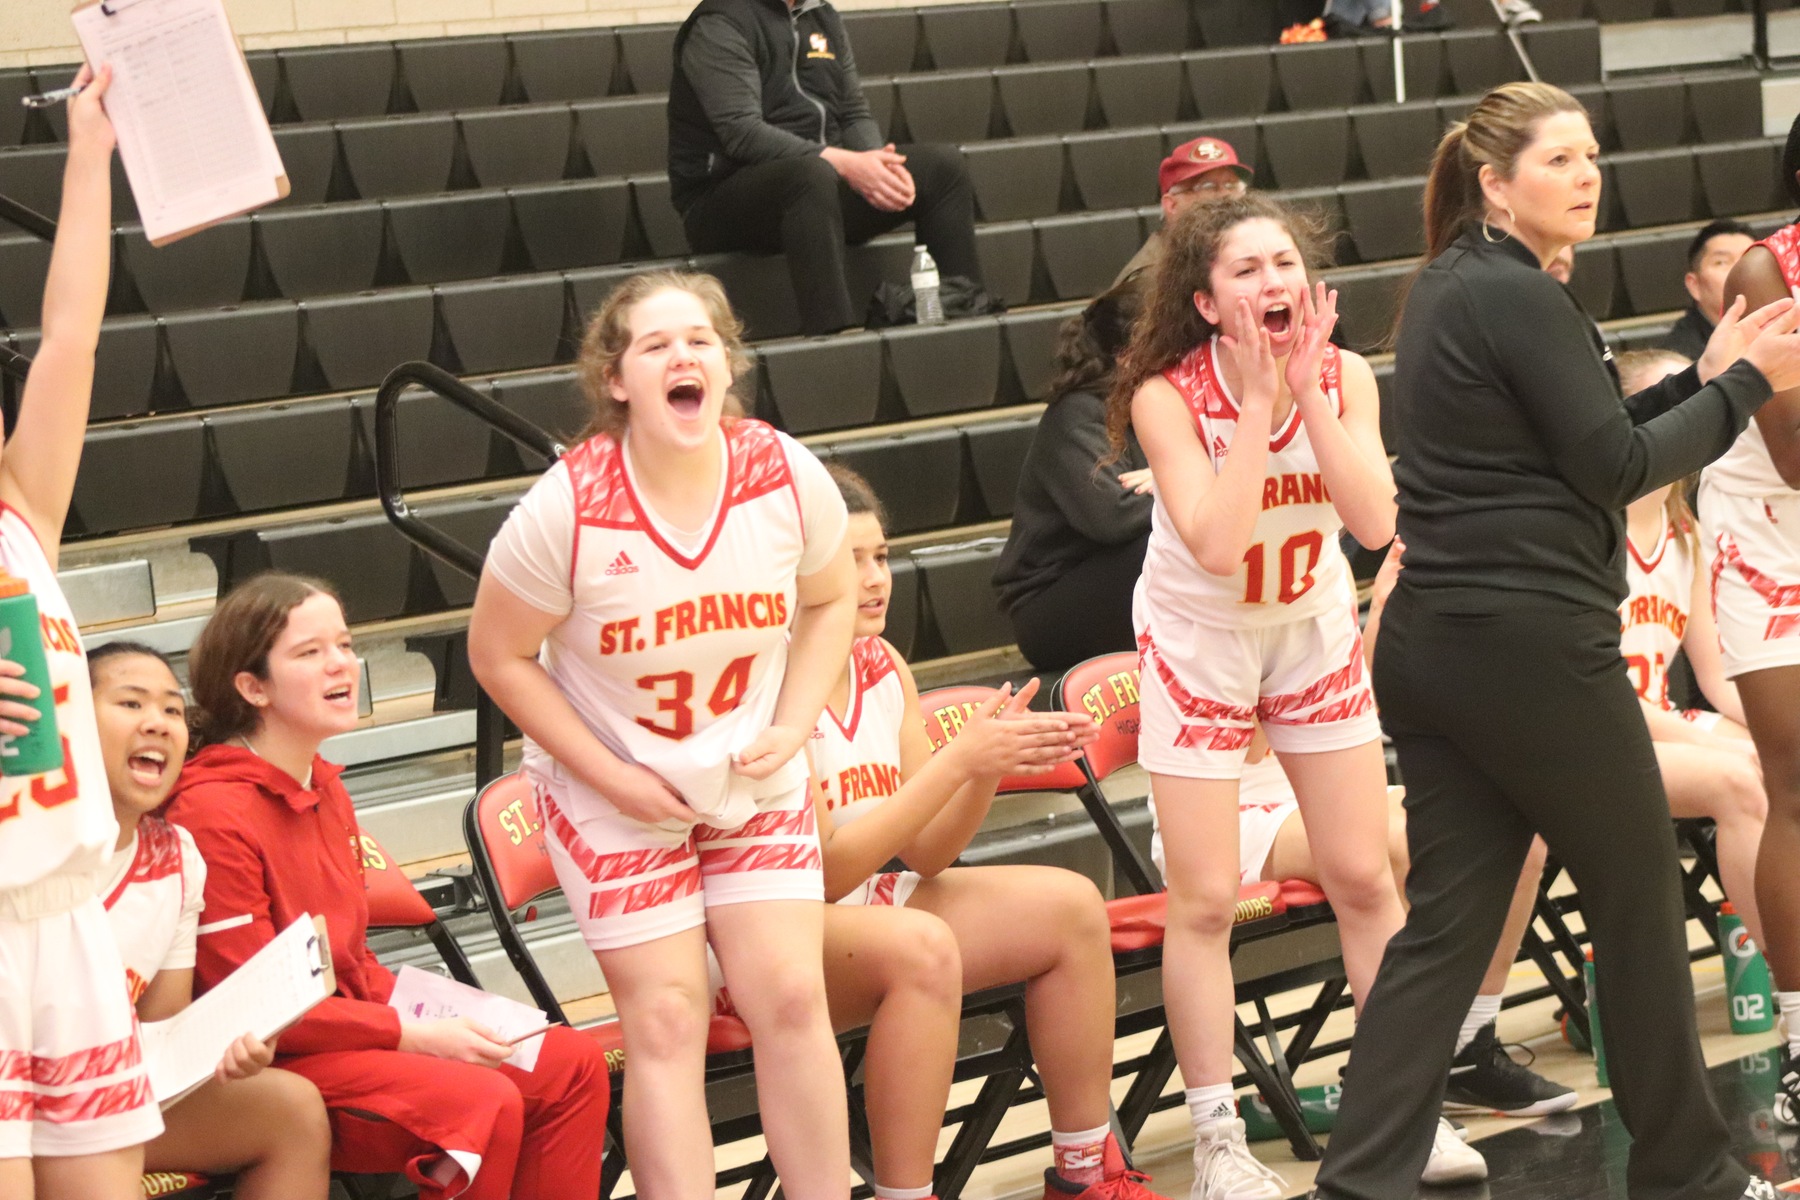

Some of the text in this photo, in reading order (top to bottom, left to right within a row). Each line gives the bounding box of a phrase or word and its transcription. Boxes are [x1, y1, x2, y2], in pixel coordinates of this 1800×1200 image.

[1237, 527, 1324, 605] 10
[600, 591, 789, 657] ST. FRANCIS
[635, 652, 760, 742] 34
[1081, 683, 1118, 726] ST.
[497, 798, 541, 847] ST.
[1732, 993, 1766, 1022] 02
